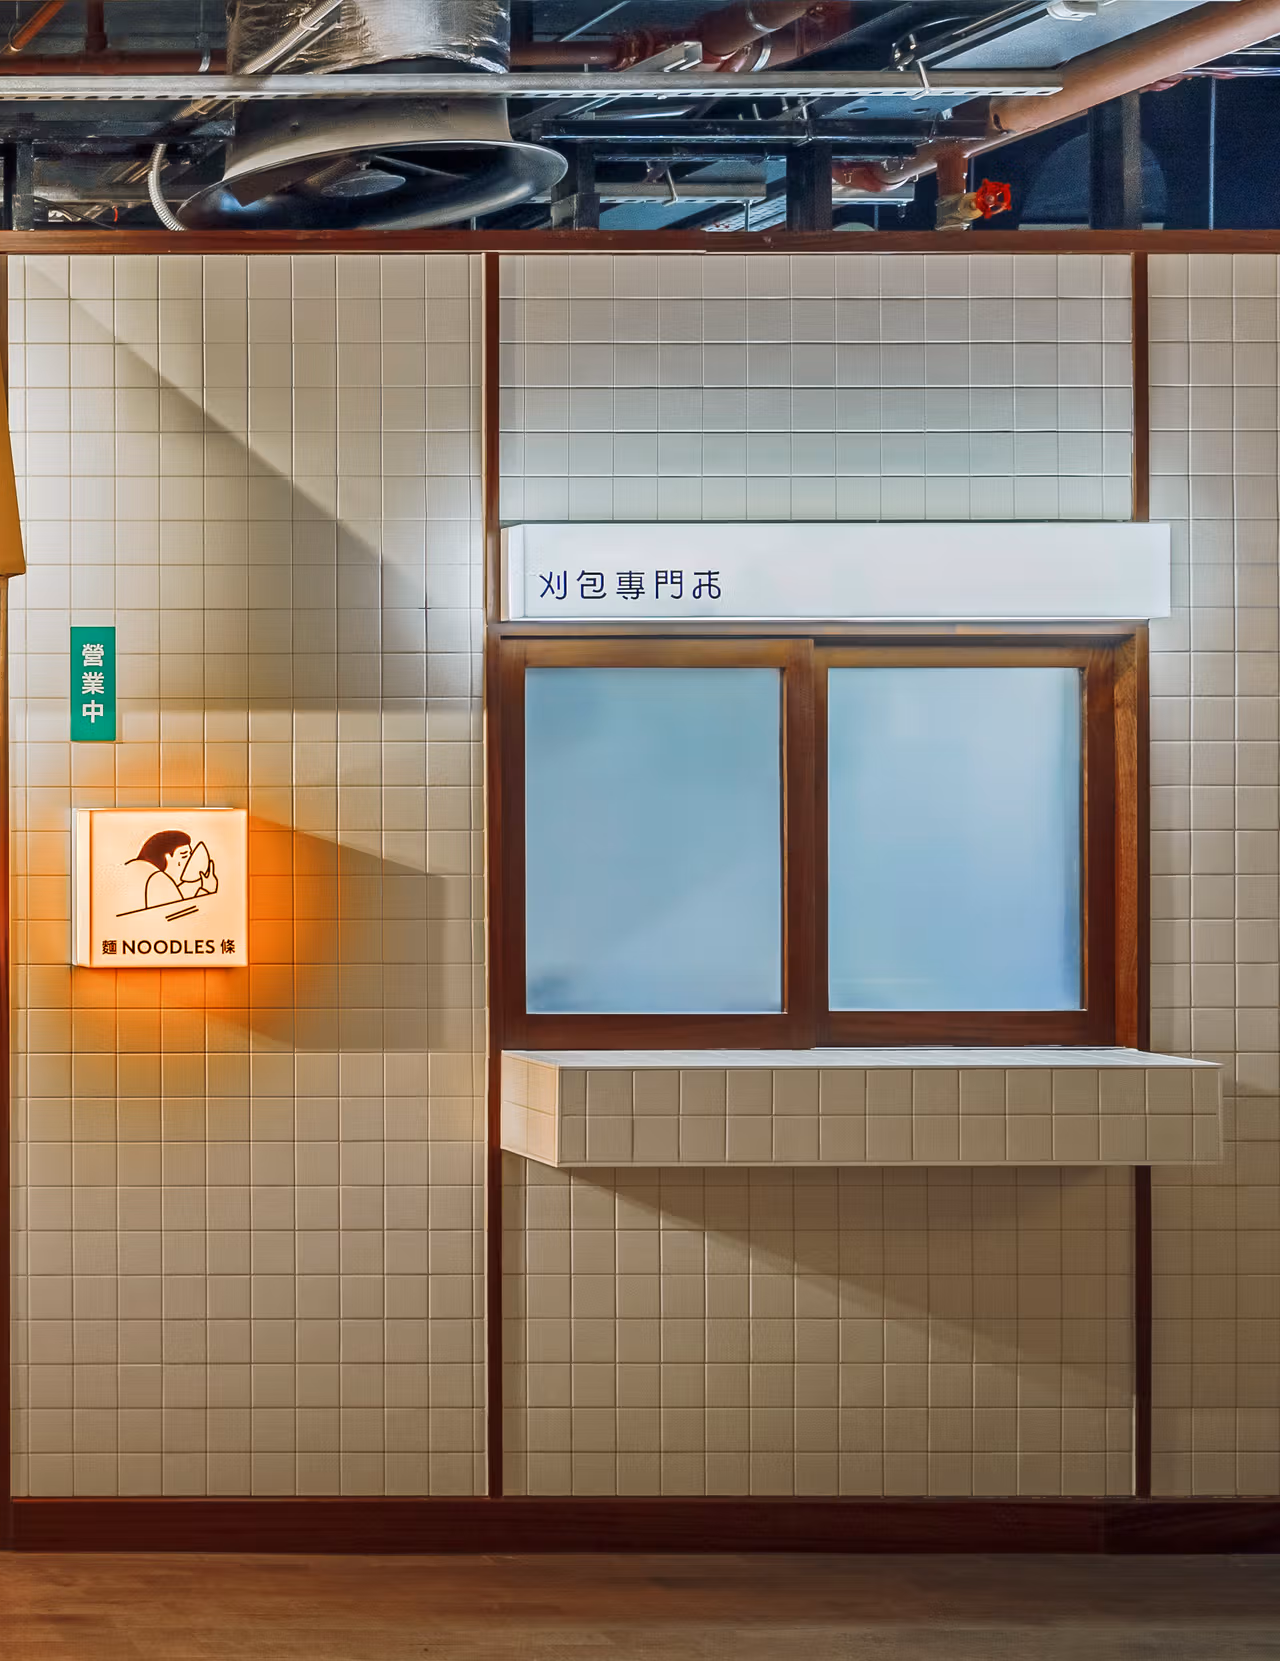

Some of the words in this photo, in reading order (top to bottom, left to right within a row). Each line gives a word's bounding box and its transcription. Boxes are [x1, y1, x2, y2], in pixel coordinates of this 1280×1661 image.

[81, 643, 105, 724] 營業中
[122, 939, 216, 955] NOODLES
[220, 938, 236, 955] 條
